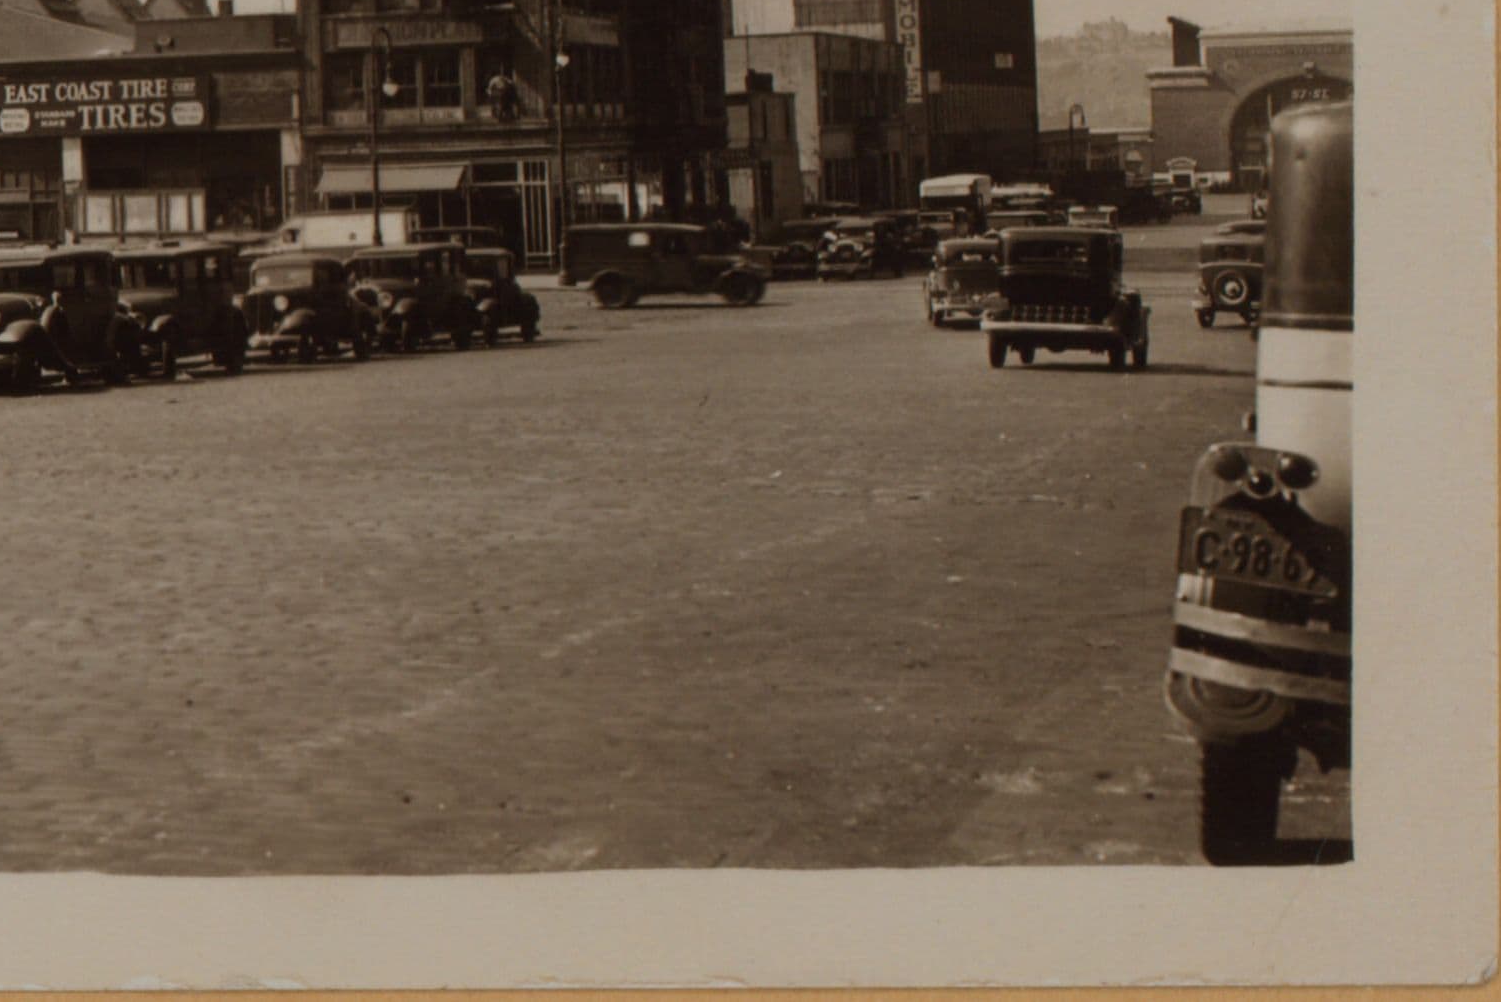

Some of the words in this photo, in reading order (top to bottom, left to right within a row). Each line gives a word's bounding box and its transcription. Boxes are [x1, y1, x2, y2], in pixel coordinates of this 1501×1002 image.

[3, 83, 50, 104] EAST
[54, 81, 113, 101] COAST
[119, 78, 168, 99] TIRE
[77, 102, 167, 130] TIRES
